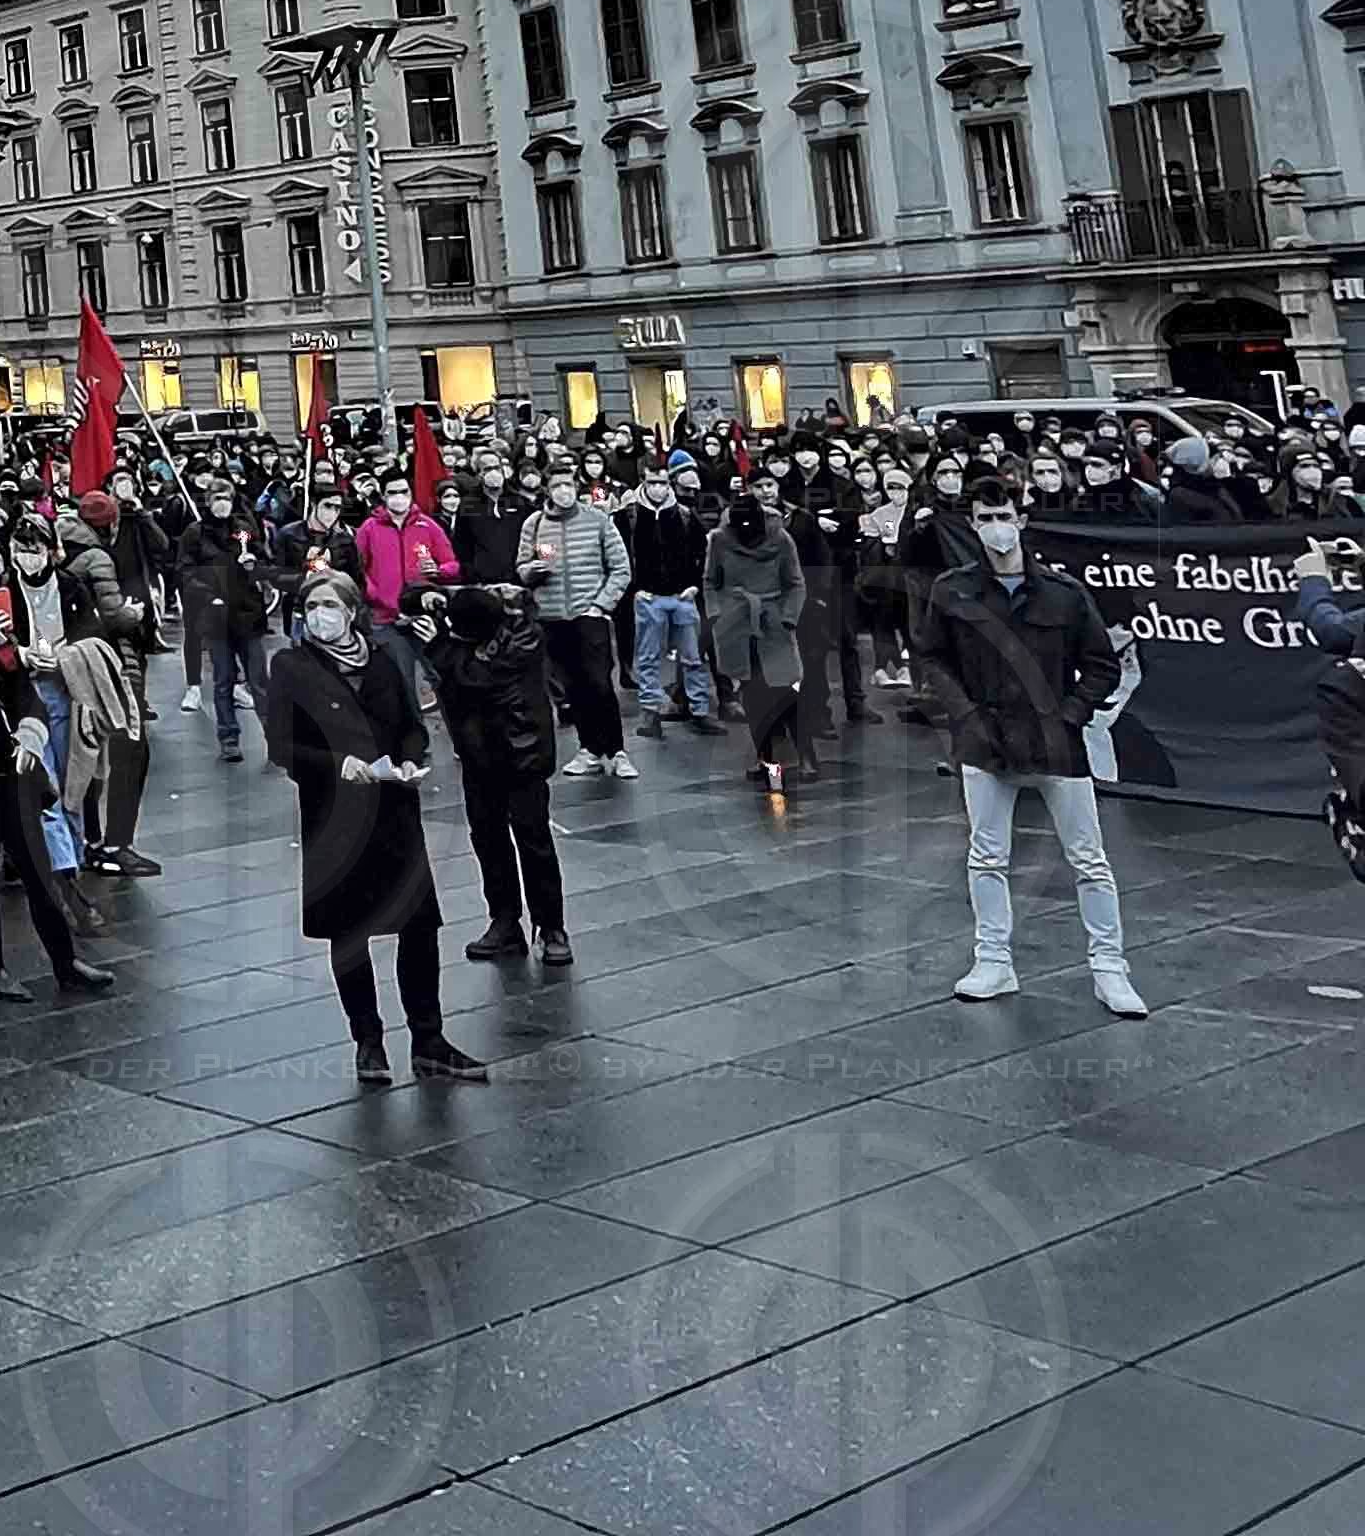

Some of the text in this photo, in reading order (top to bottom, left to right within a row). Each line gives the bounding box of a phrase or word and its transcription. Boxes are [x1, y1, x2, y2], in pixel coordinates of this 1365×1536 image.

[326, 104, 362, 252] CASINO
[1083, 552, 1157, 589] eine
[1172, 552, 1364, 594] fabelhae
[1130, 601, 1226, 645] ohne
